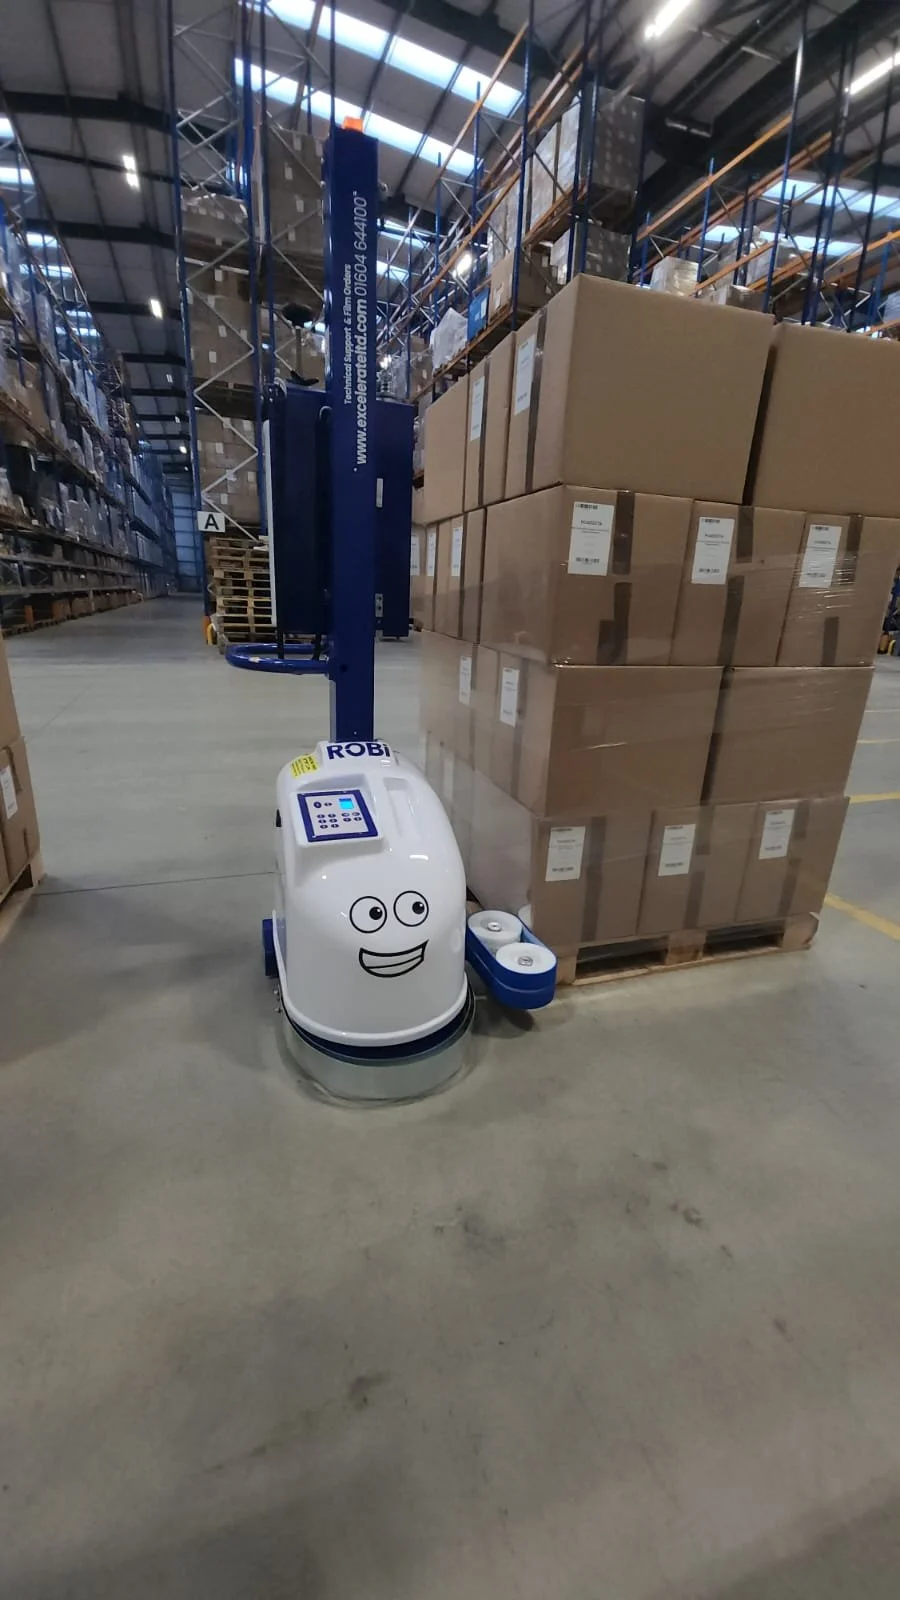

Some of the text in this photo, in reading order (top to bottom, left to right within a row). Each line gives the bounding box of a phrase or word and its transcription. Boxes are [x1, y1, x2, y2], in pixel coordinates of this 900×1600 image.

[343, 264, 354, 404] Technical Support & Film Orders
[354, 197, 367, 464] www.excelerateltd.com 01604 644100
[204, 513, 219, 530] A
